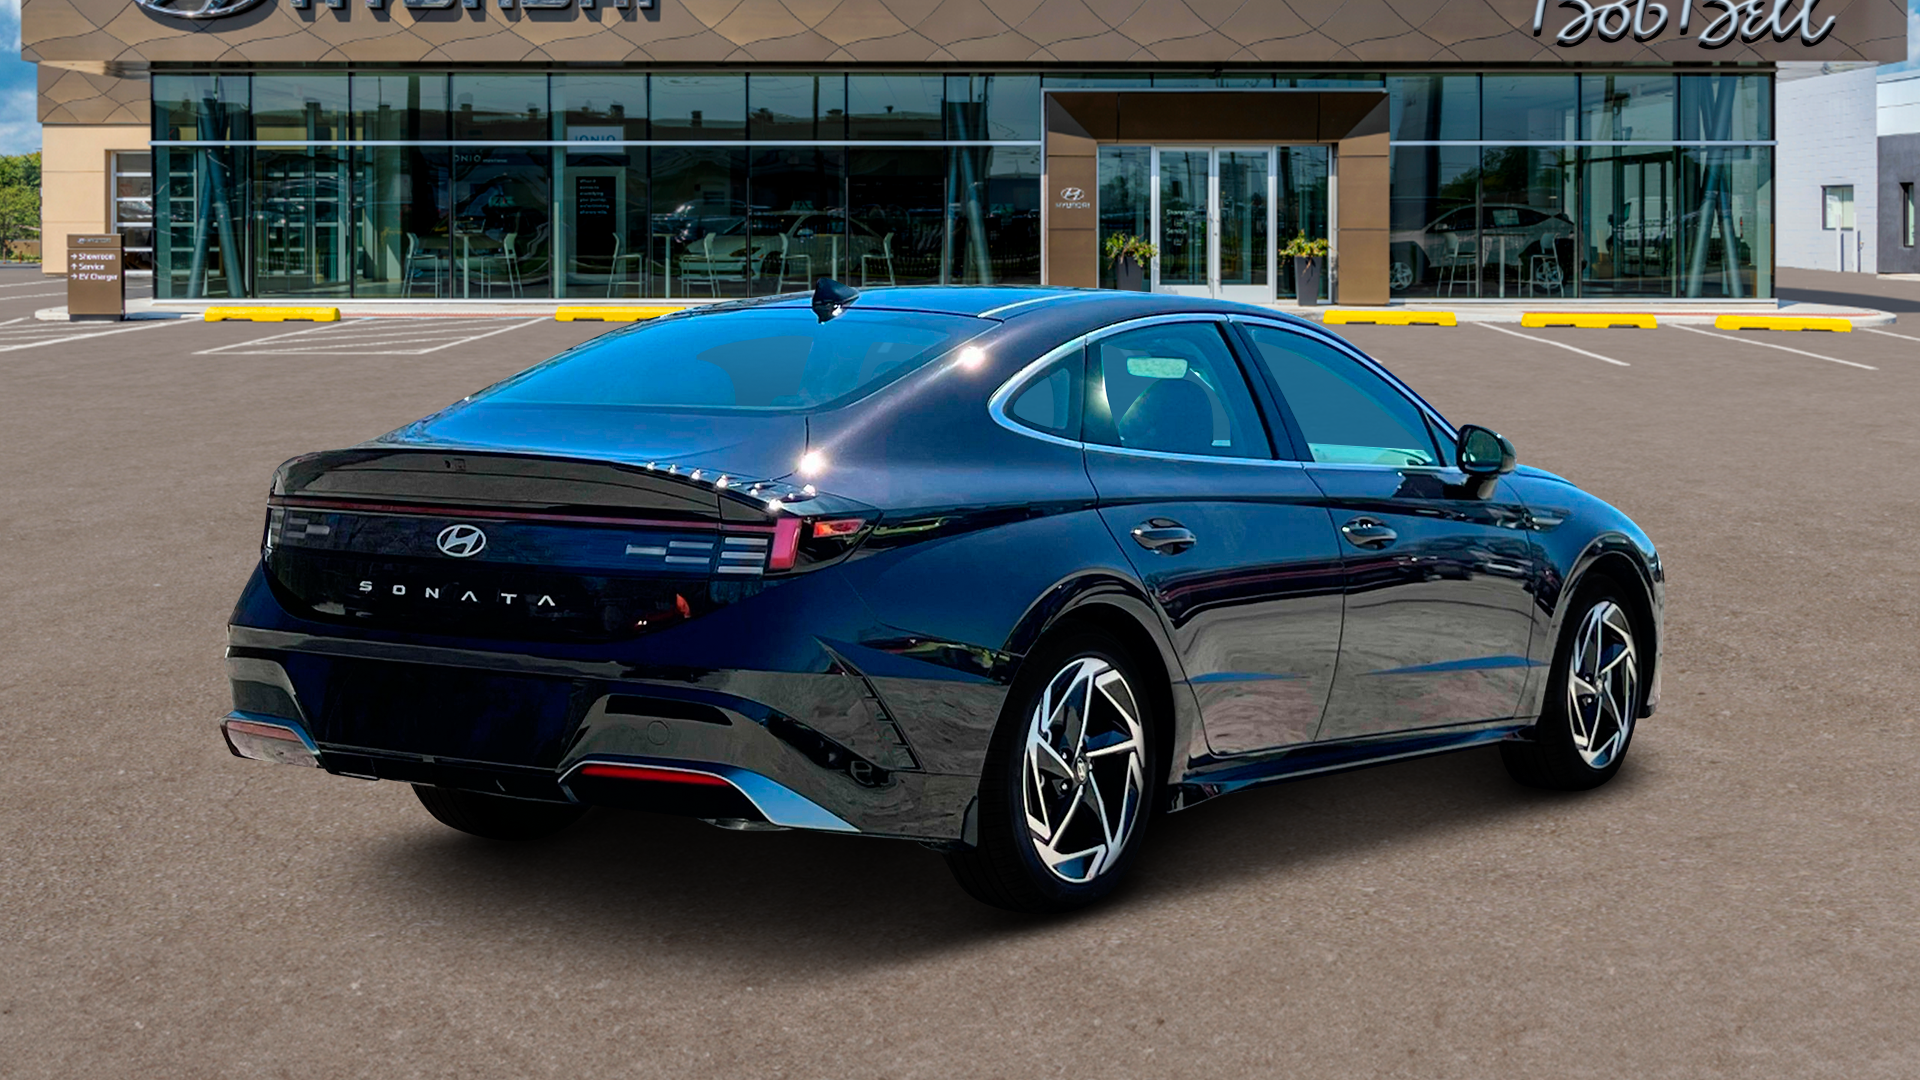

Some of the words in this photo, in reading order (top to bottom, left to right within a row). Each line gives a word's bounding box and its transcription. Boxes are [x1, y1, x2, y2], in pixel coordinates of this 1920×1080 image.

[78, 253, 116, 261] Showroom
[78, 262, 105, 270] Service
[90, 273, 118, 282] Charger
[359, 580, 556, 607] SONATA
